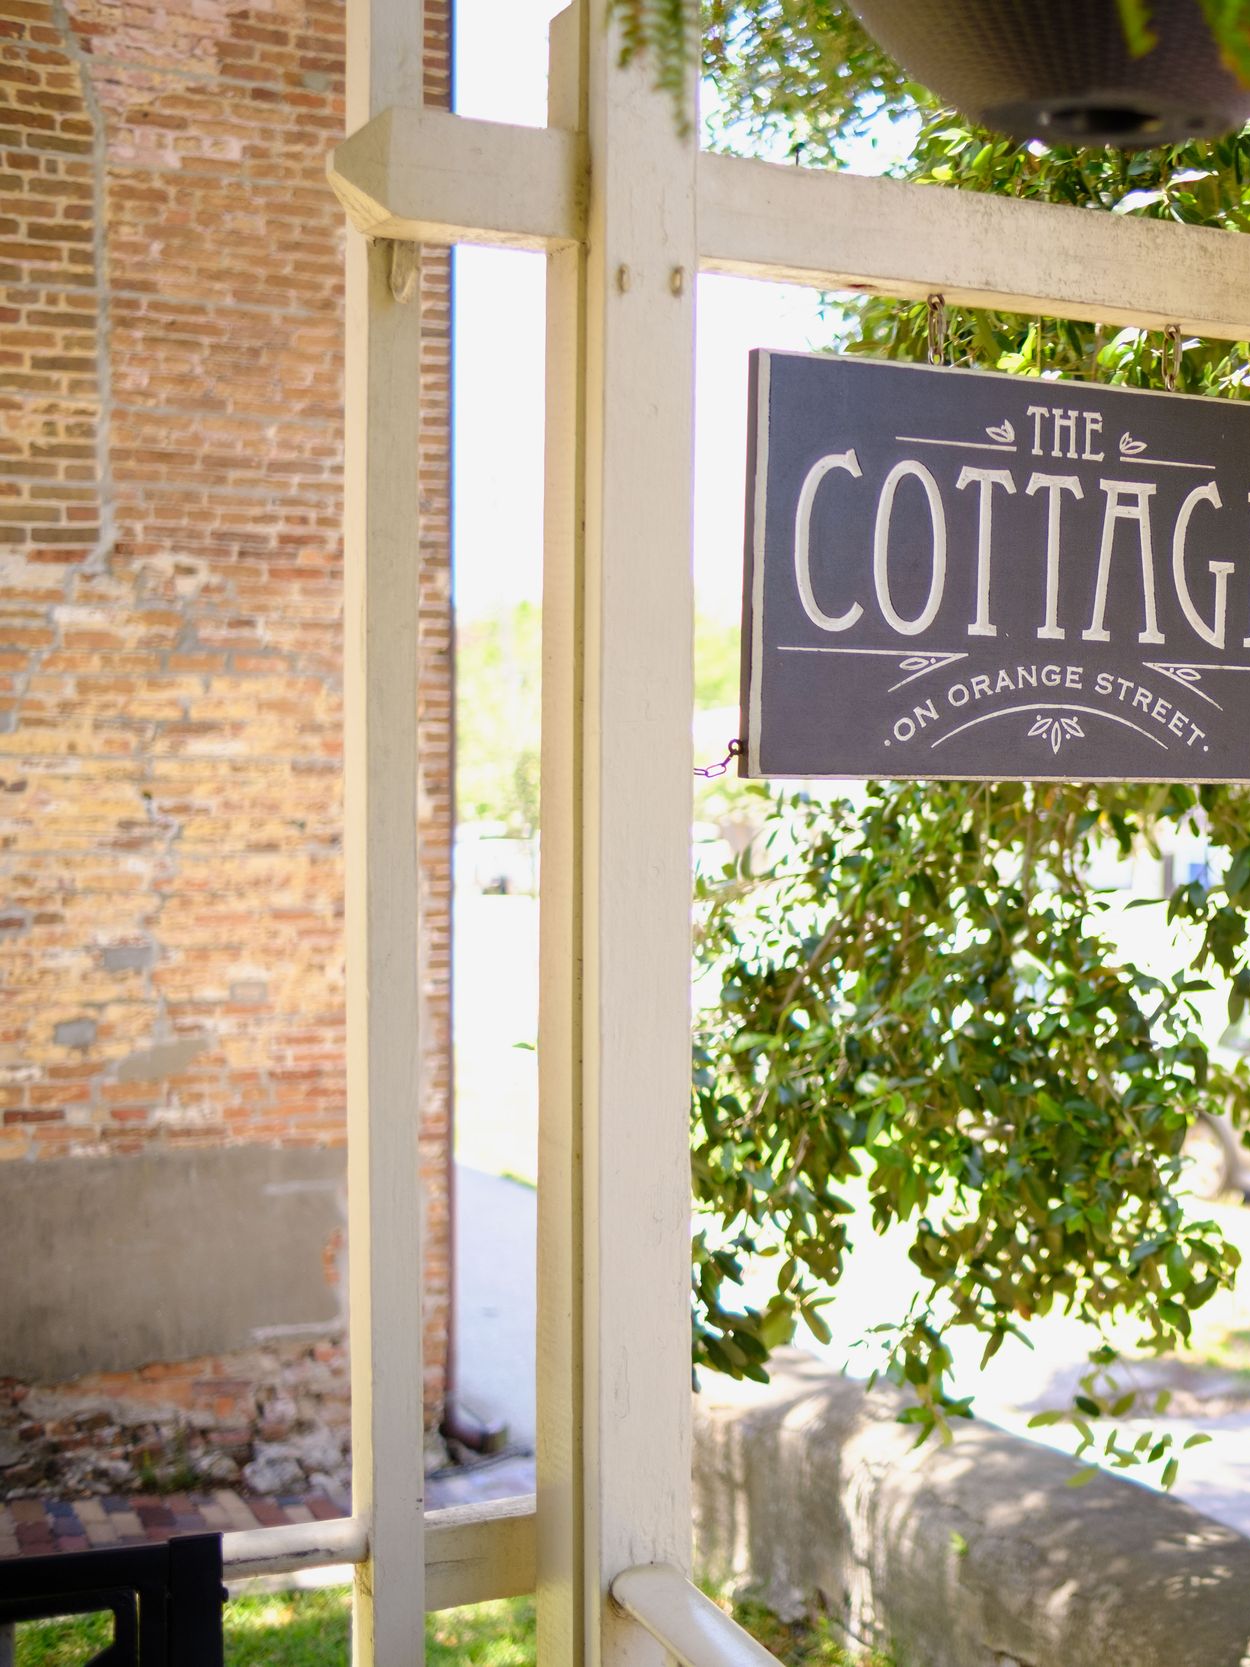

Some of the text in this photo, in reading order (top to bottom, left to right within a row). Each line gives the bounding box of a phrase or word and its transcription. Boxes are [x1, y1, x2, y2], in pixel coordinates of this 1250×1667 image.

[1026, 405, 1105, 462] THE
[893, 664, 1206, 747] ON ORANGE STREET
